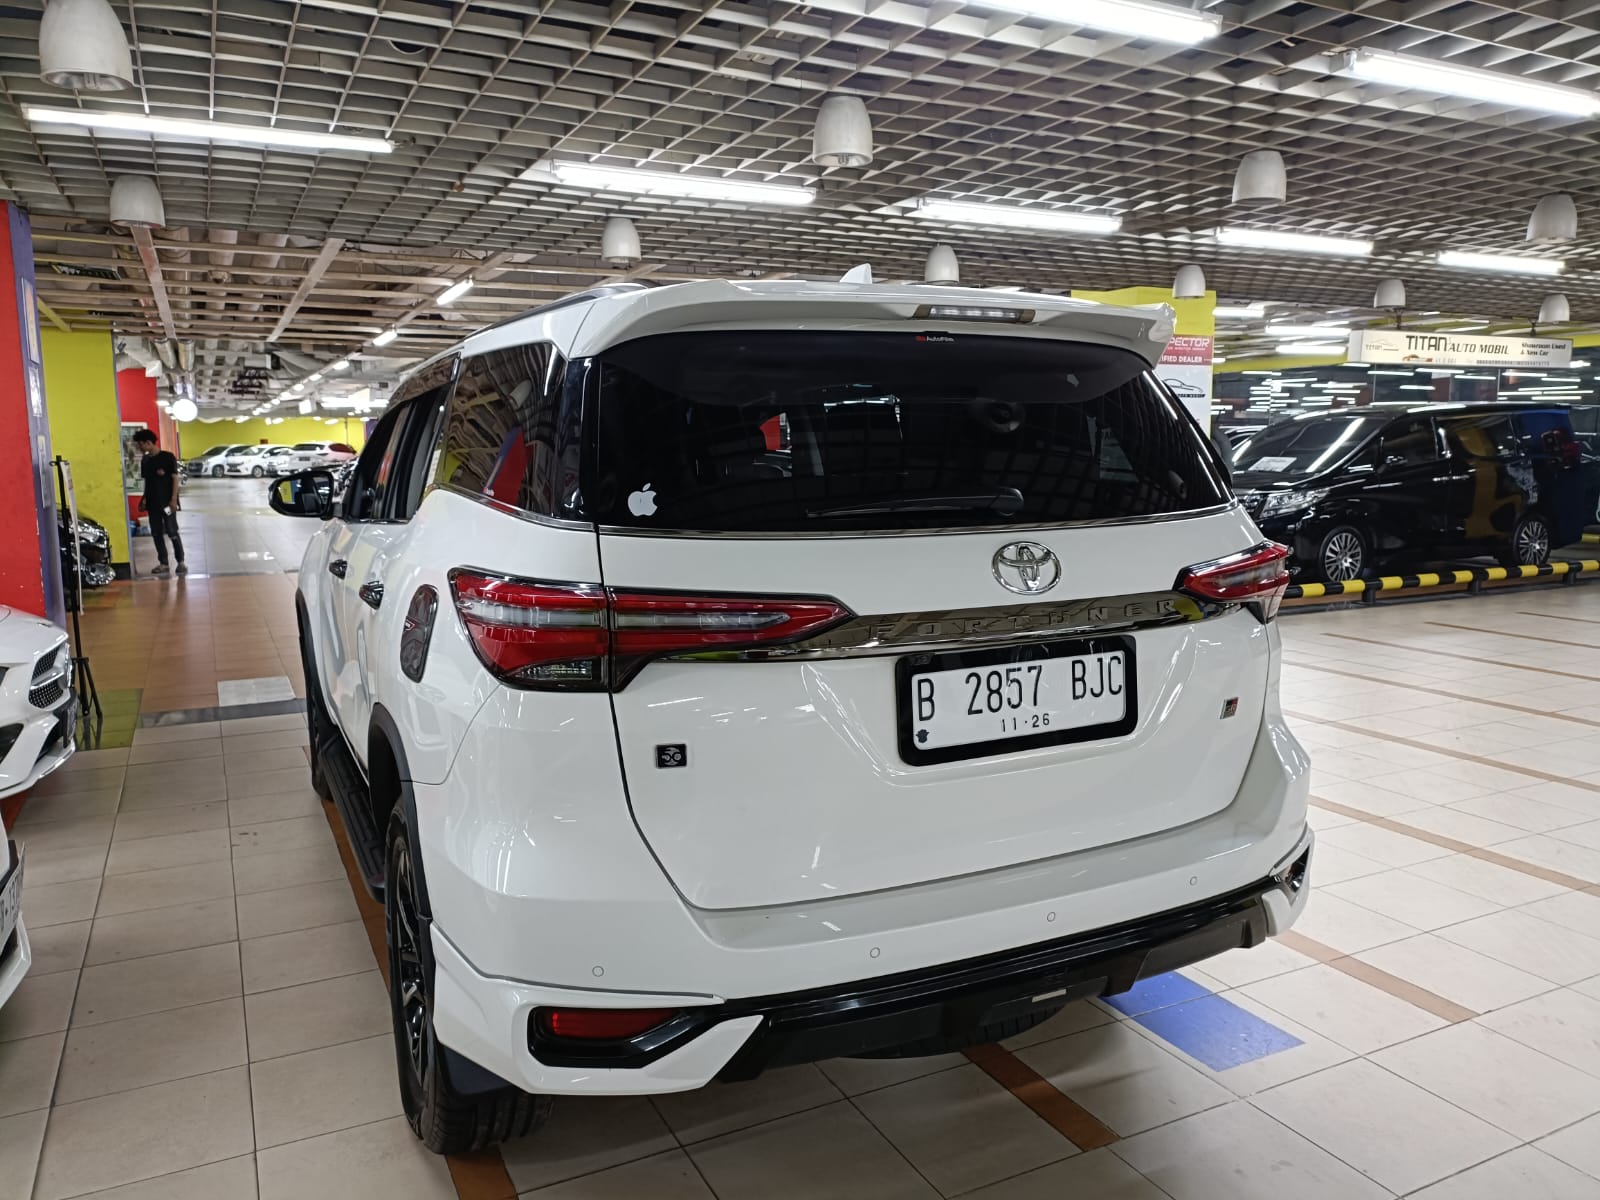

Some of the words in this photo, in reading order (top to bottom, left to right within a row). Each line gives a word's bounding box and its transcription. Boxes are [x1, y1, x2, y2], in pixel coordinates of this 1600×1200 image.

[1406, 335, 1447, 351] TITAN
[1449, 342, 1476, 353] AUTO
[1479, 344, 1510, 355] MOBIL
[869, 600, 1177, 637] FORTUNER
[917, 678, 935, 722] B
[964, 664, 1043, 715] 2857
[1071, 655, 1123, 701] BJC
